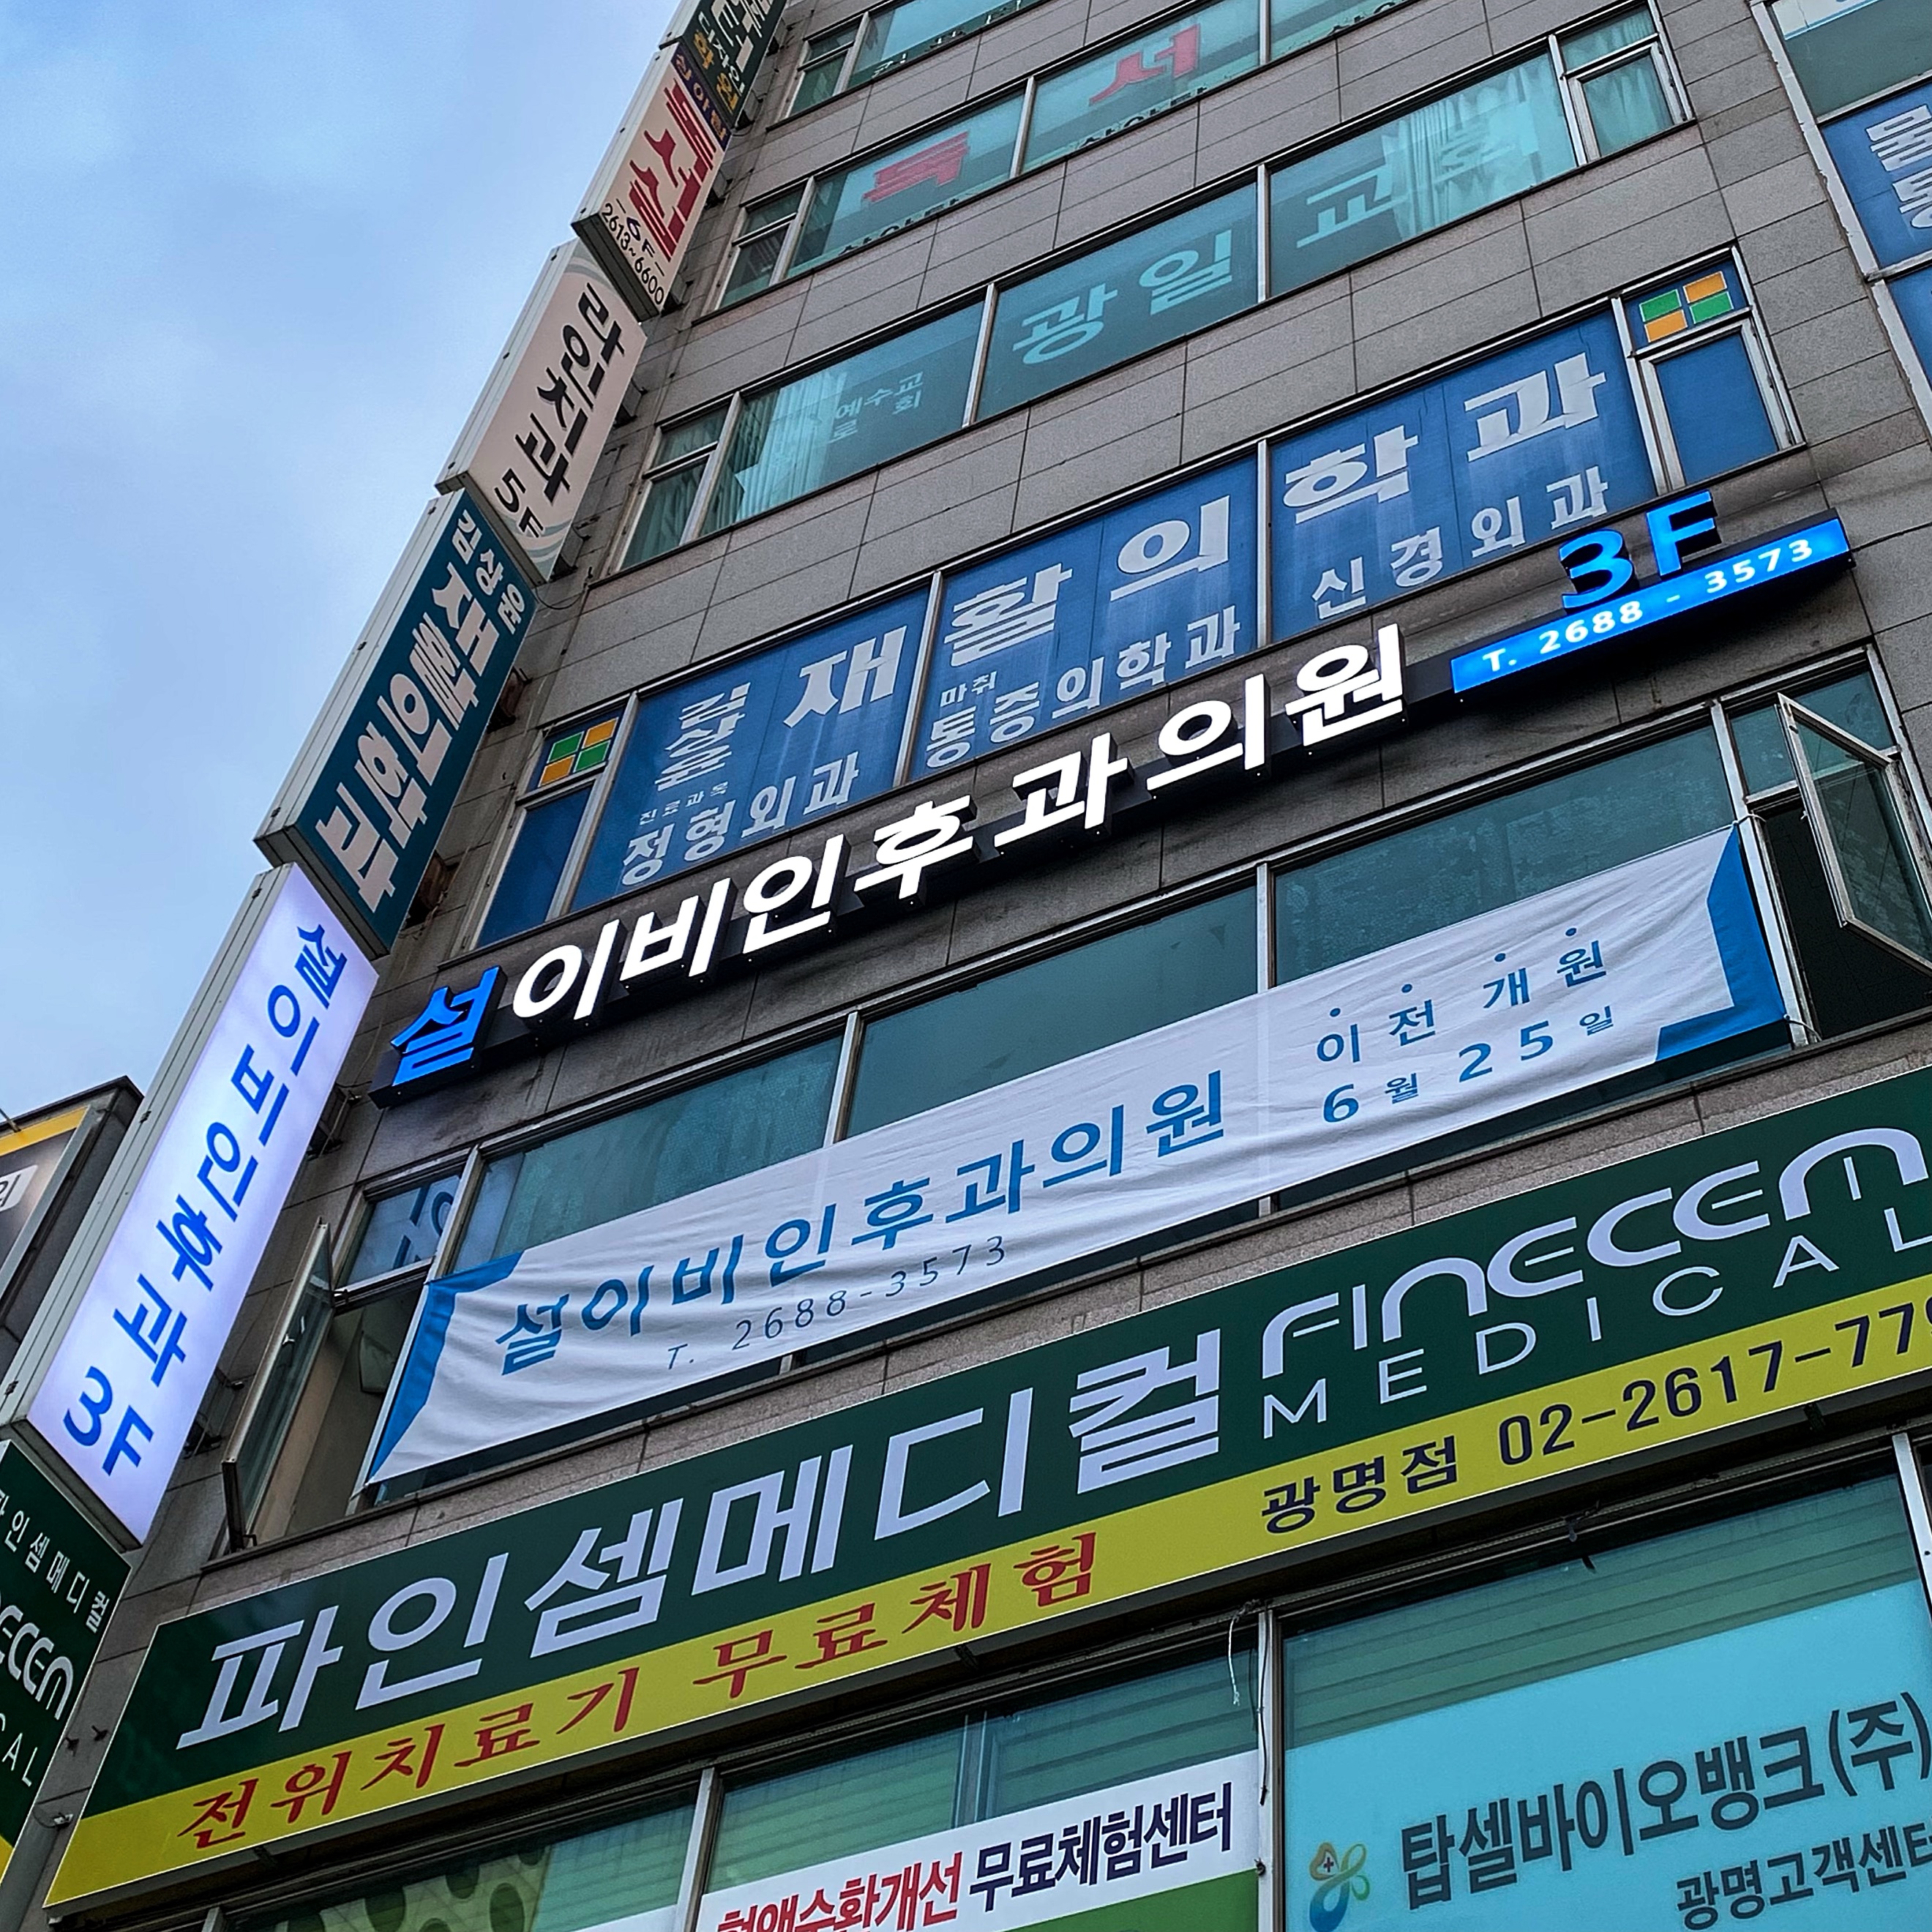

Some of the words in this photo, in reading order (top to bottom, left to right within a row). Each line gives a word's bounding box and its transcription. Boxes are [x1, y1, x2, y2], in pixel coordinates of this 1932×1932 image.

[629, 78, 716, 263] 독서실
[515, 282, 625, 503] 라인치과
[452, 509, 525, 634] 김상윤
[495, 468, 543, 538] 5F
[1311, 465, 1608, 621] 신경외과
[1559, 491, 1718, 610] 3F
[315, 562, 500, 913] 재활의학과
[926, 605, 1241, 768] 통증의학과
[940, 671, 997, 708] 마취
[621, 751, 859, 886] 정형외과
[1317, 1000, 1435, 1063] 이전
[1483, 939, 1607, 1007] 개원
[113, 924, 348, 1387] 설이비인후과
[495, 1070, 1224, 1376] 설이비인후과의원
[667, 1344, 695, 1370] T.
[732, 1235, 1005, 1350] 2688-3573
[1263, 1208, 1932, 1439] MEDICAL
[63, 1366, 154, 1477] 3F
[176, 1328, 1221, 1750] 파인셈메디컬
[177, 1667, 640, 1849] 전위치료기
[692, 1532, 1096, 1699] 무료체험
[1262, 1435, 1459, 1534] 광명점
[1498, 1296, 1932, 1466] 02-2617-77
[970, 1782, 1232, 1912] 무료체험센터
[1401, 1692, 1932, 1910] 탑셀바이오뱅크(주)
